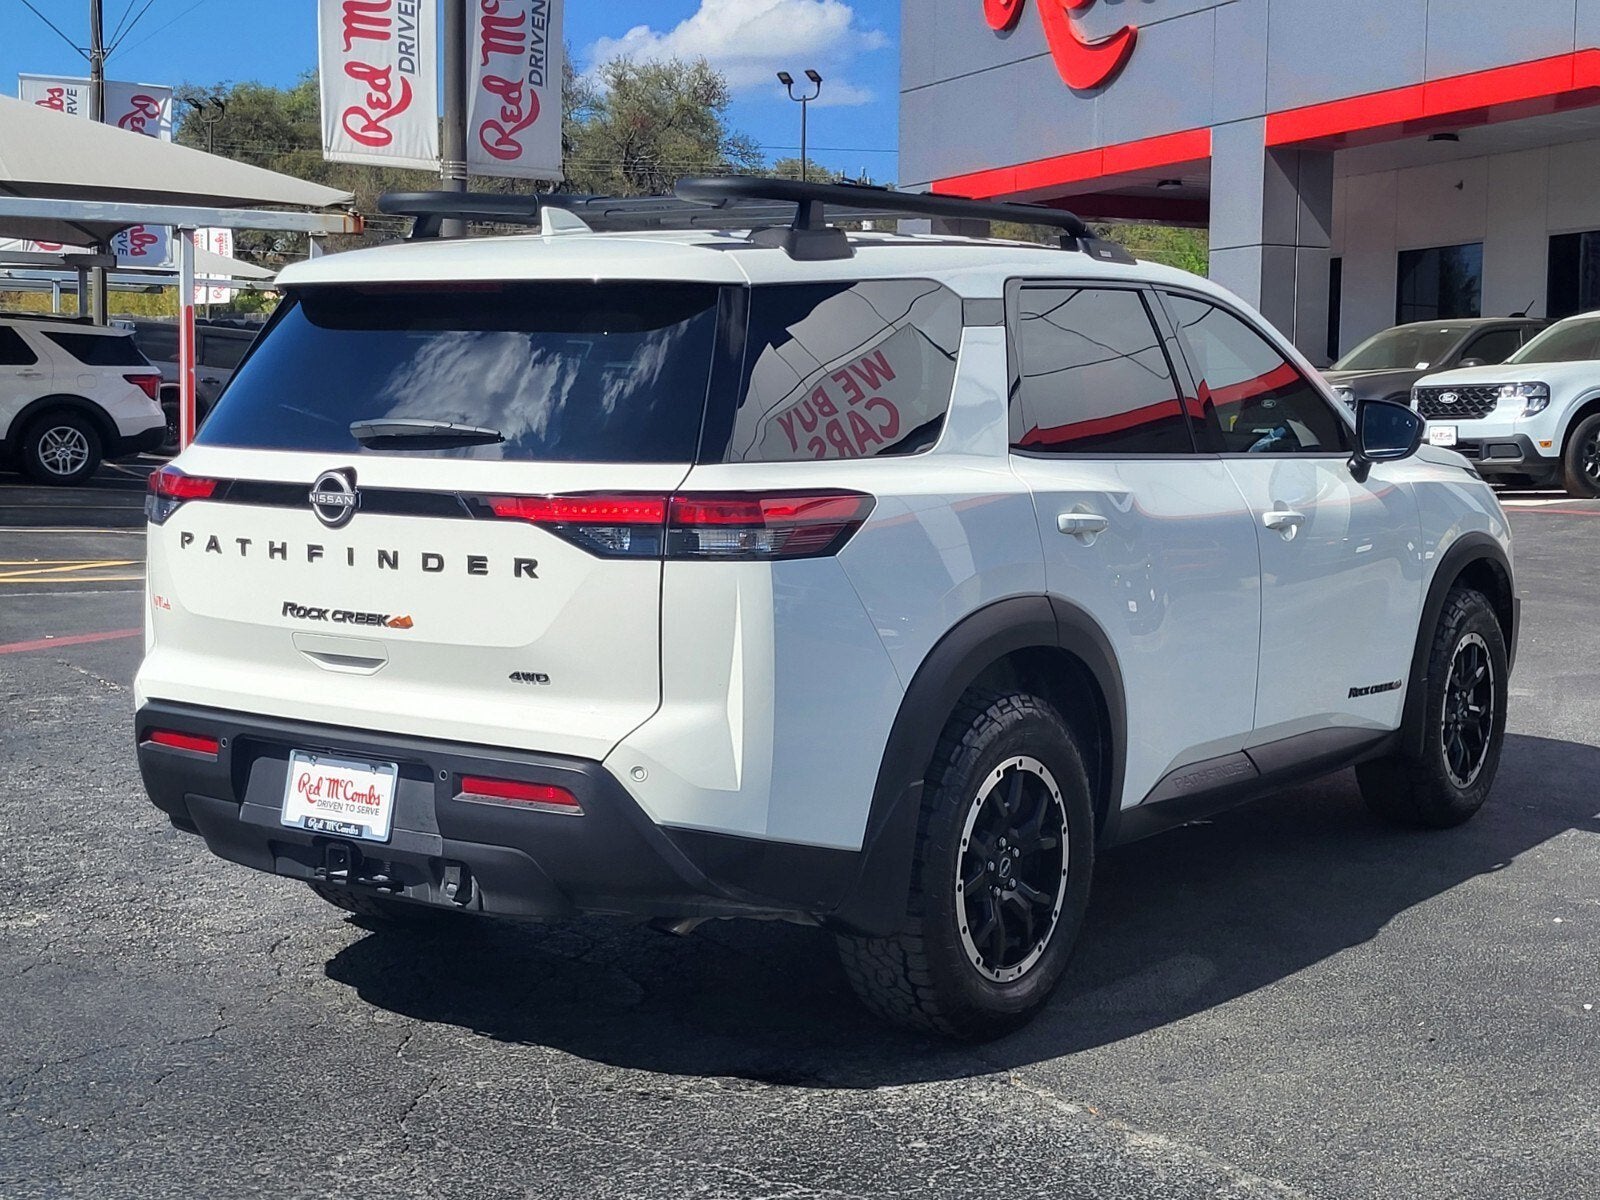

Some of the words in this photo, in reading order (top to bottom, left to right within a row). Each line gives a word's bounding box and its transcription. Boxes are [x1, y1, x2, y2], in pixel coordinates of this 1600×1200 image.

[398, 0, 415, 75] DRIVE
[529, 0, 547, 87] DRIVEN
[342, 61, 413, 147] Red
[479, 75, 541, 160] Red
[309, 493, 355, 505] NISSAN
[180, 531, 540, 580] PATHFINDER
[282, 601, 330, 621] ROCK
[331, 609, 391, 627] CREEK
[509, 671, 550, 685] 4WD
[298, 772, 323, 804] Red
[325, 776, 381, 807] McCombs
[307, 817, 324, 830] Red
[316, 799, 343, 811] DRIVEN
[345, 803, 356, 812] TO
[356, 805, 380, 816] SERVE
